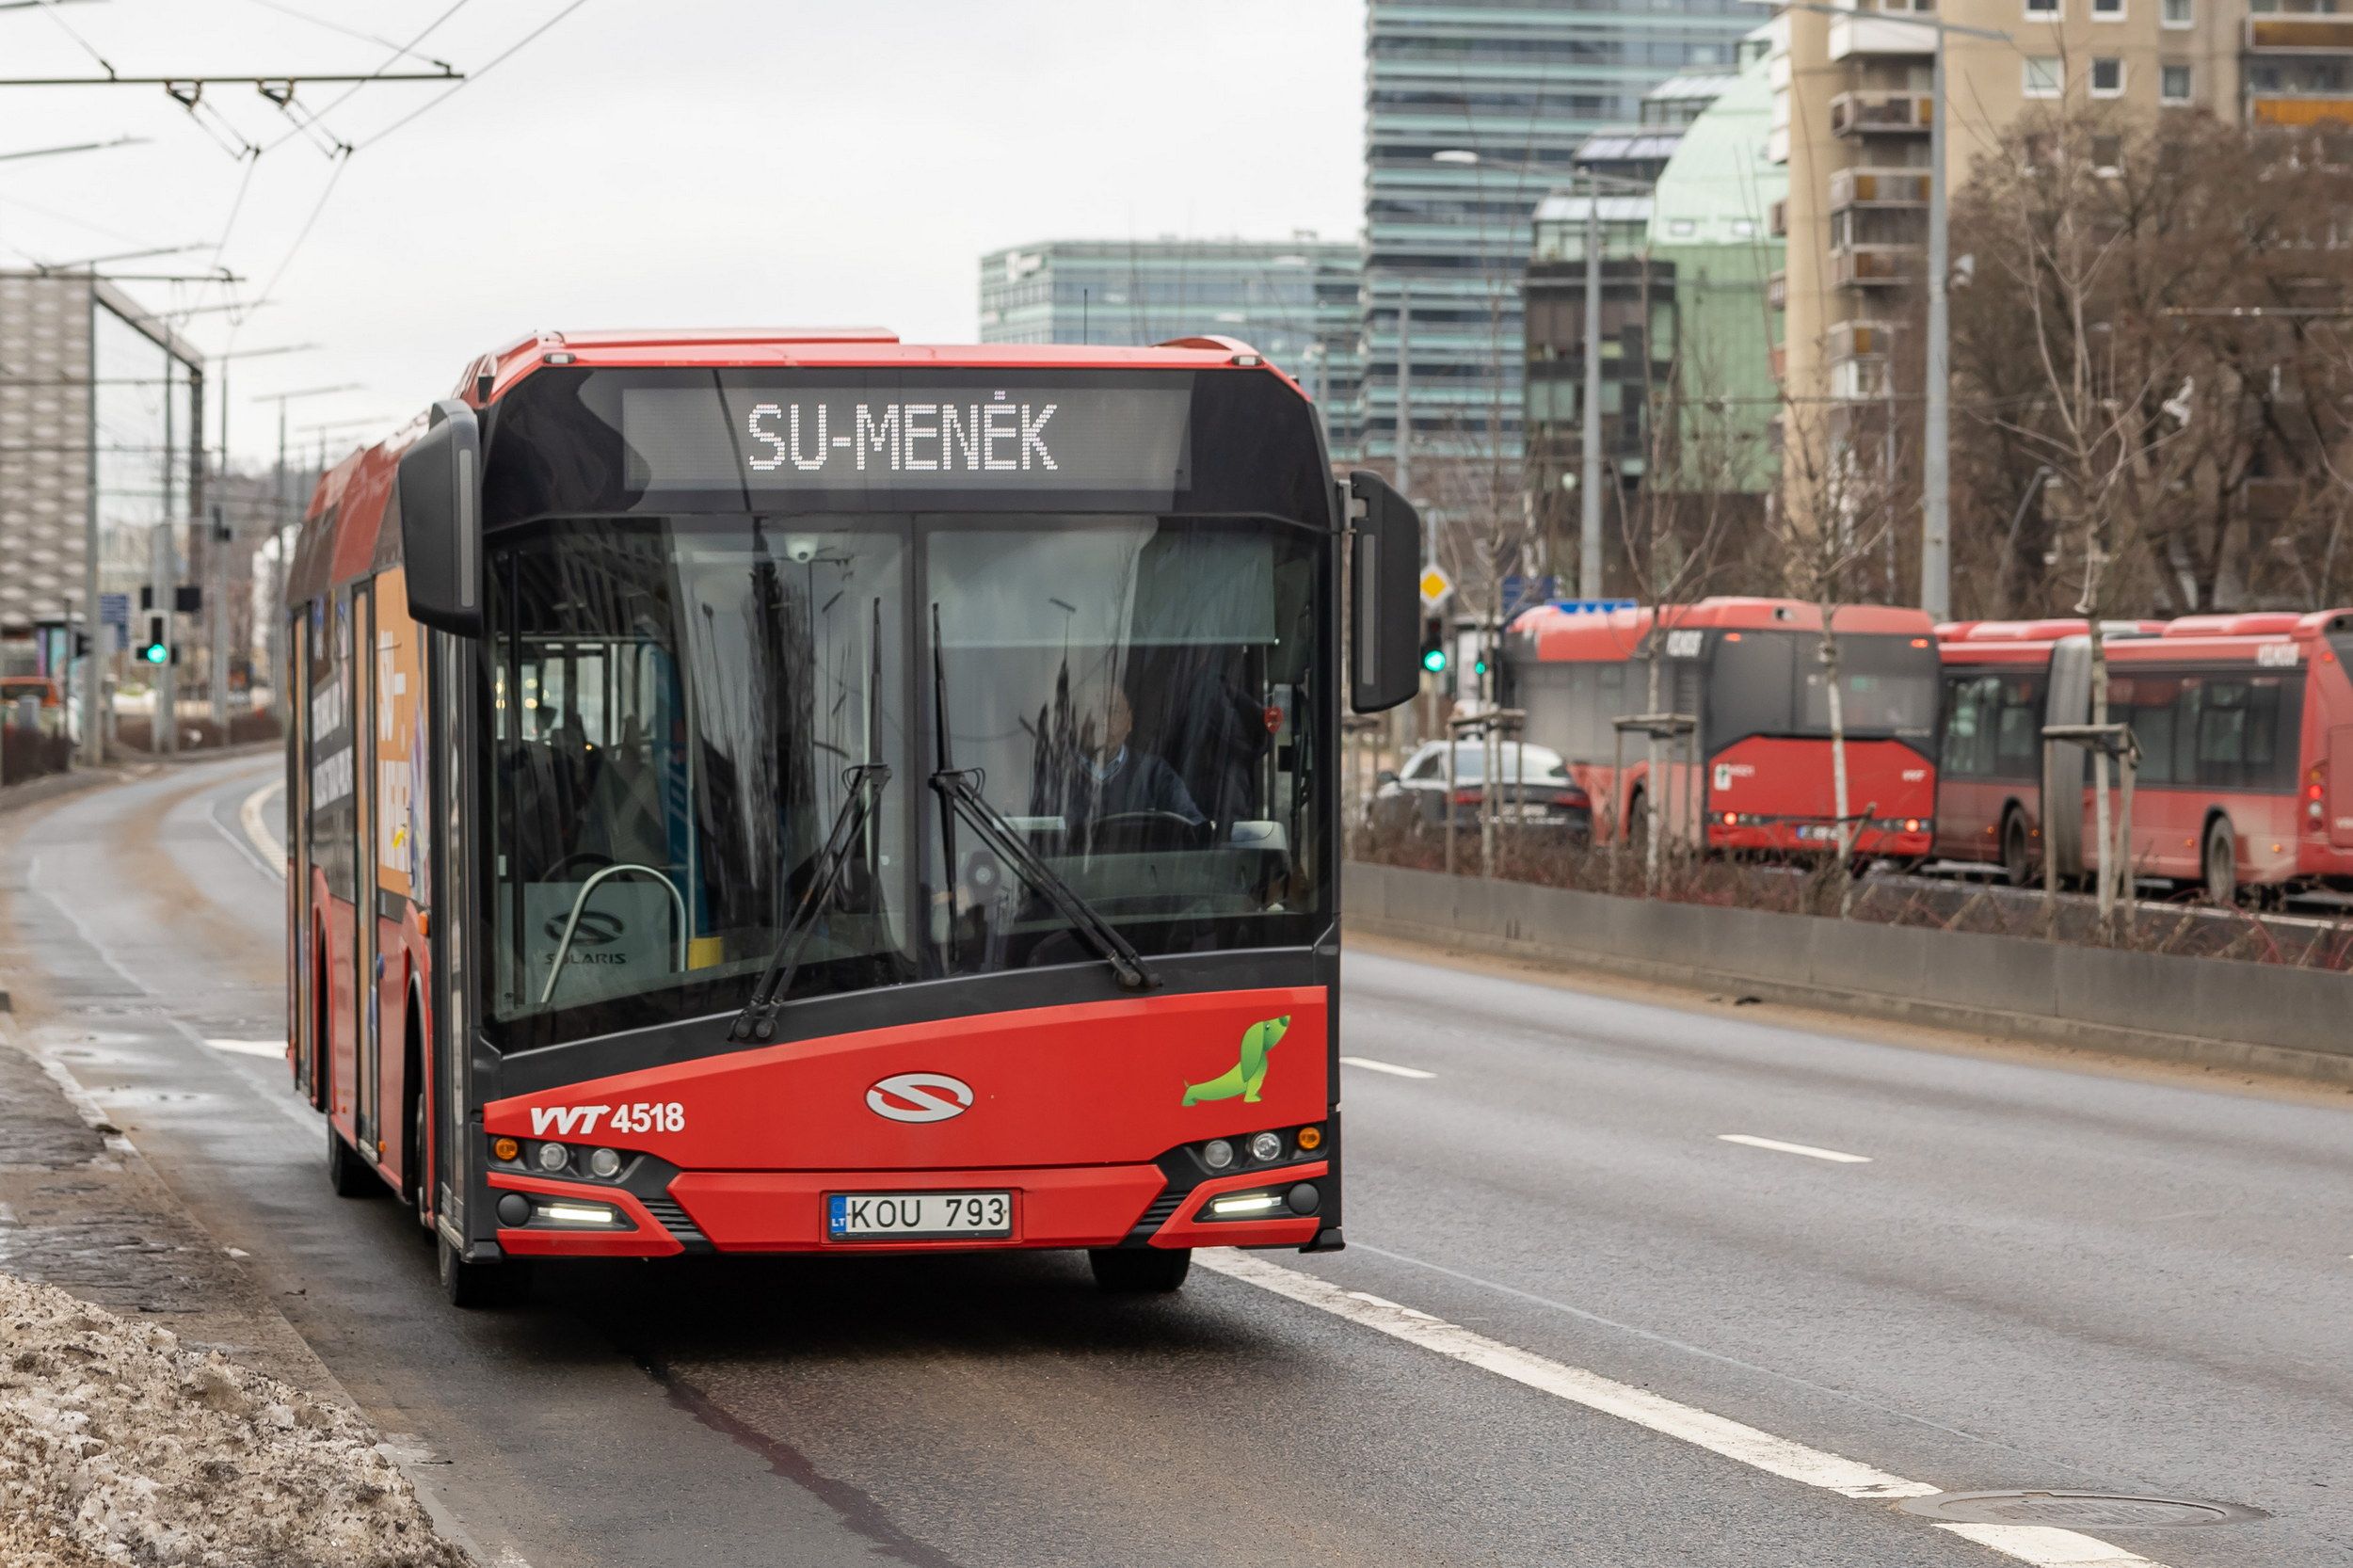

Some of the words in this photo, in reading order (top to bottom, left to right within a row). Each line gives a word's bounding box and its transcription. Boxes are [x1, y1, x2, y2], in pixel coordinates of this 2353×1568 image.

[749, 390, 1058, 471] SU-MENĖK
[545, 952, 627, 966] SLARIS
[611, 1102, 686, 1133] 4518
[832, 1218, 846, 1226] LT
[851, 1199, 921, 1228] KOU
[946, 1197, 1004, 1227] 793
